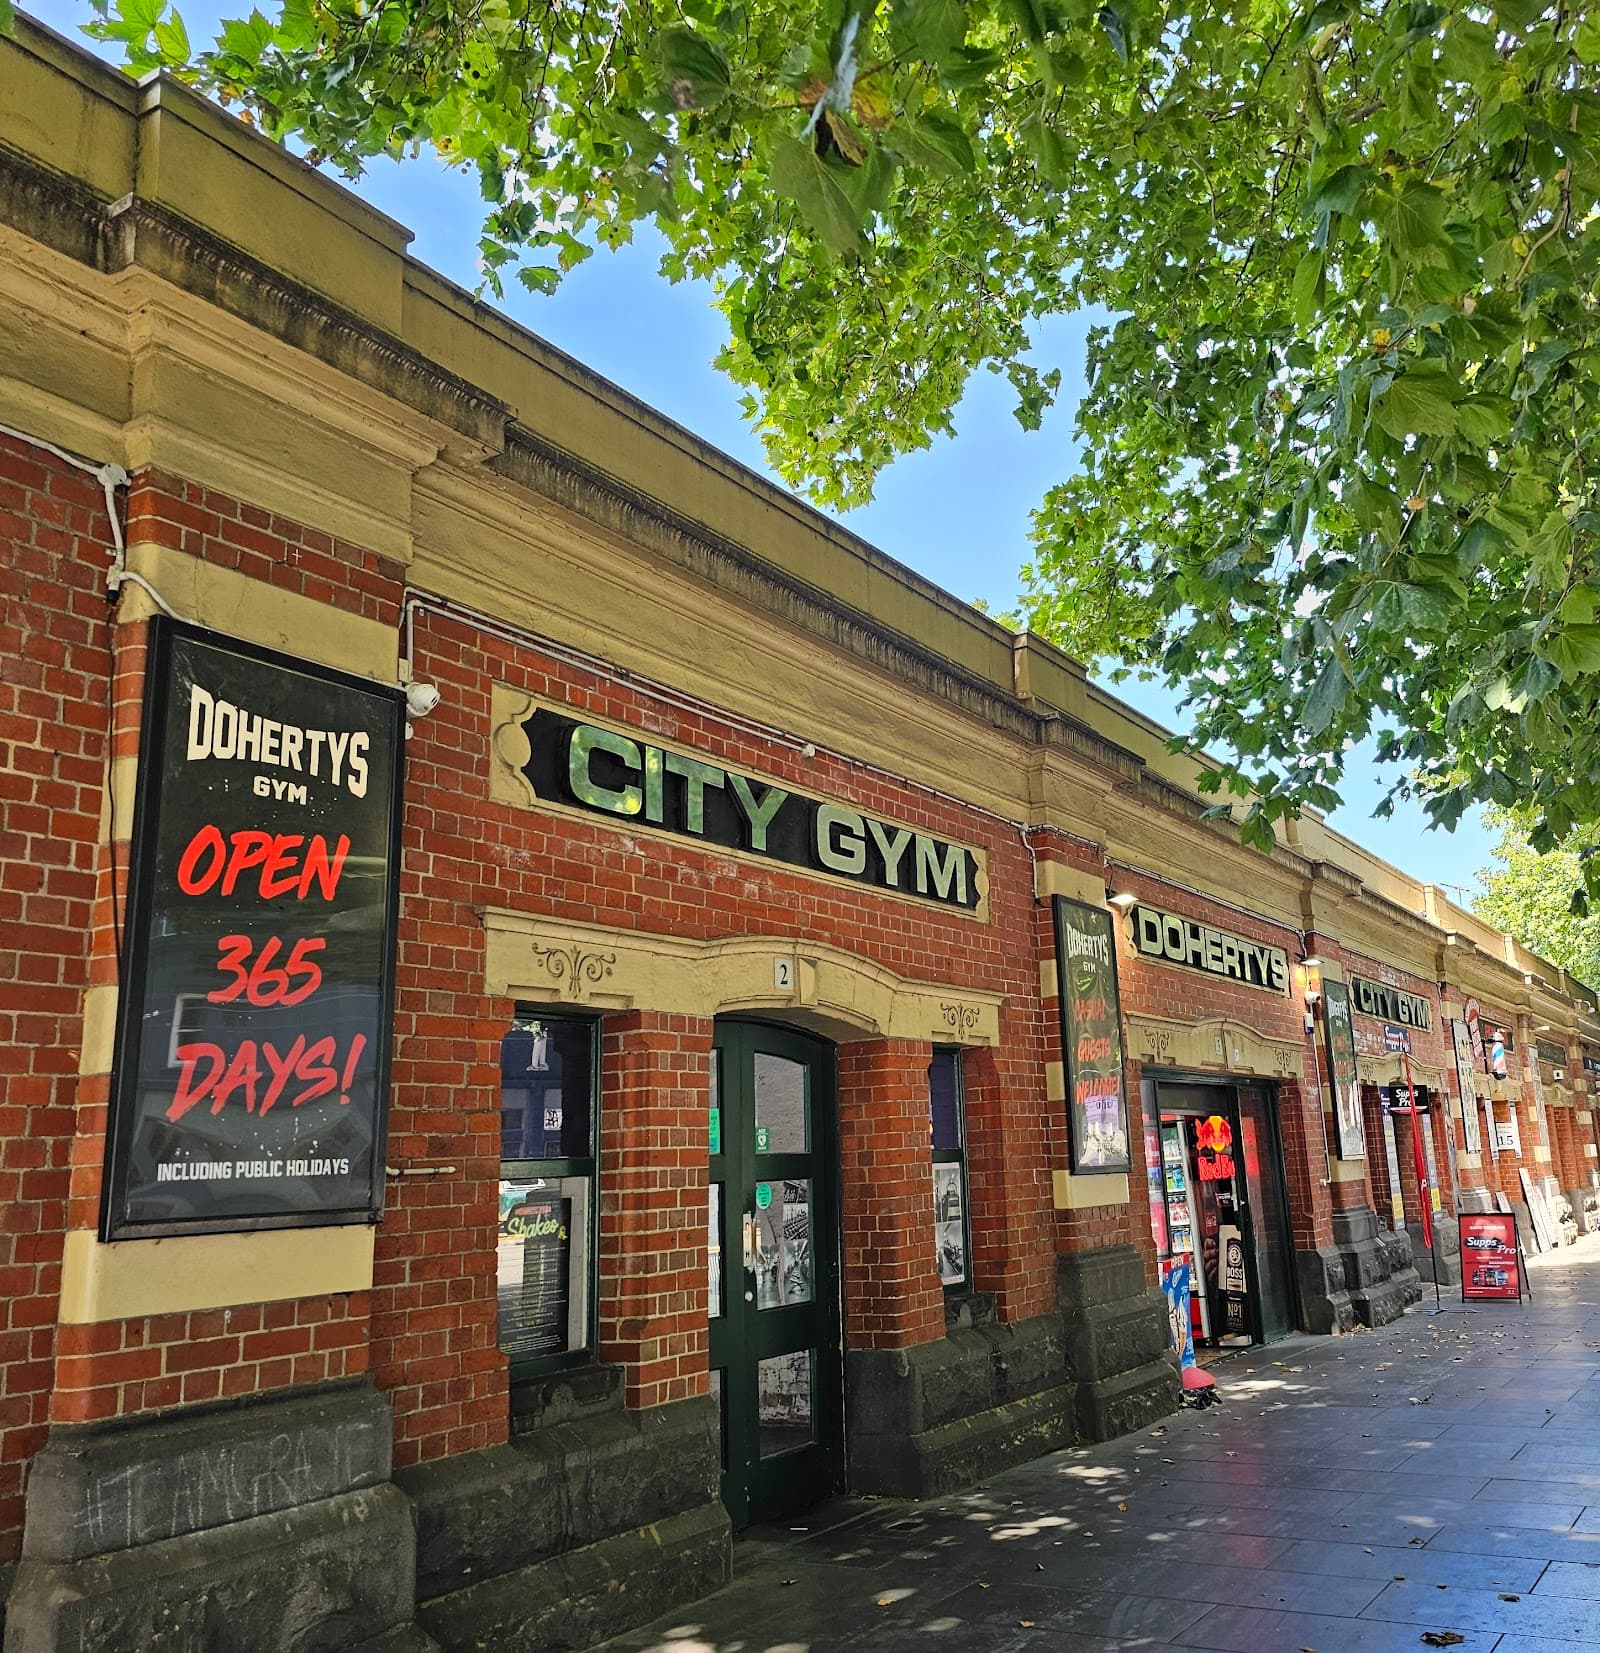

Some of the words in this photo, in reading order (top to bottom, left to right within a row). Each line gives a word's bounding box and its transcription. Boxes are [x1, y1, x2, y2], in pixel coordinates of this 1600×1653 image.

[187, 683, 370, 799] DOHERTYS
[253, 775, 308, 805] GYM
[569, 724, 788, 850] CITY
[816, 803, 967, 904] GYM
[177, 824, 351, 901] OPEN
[1066, 922, 1109, 967] DOHERTYS
[1137, 906, 1287, 990] DOHERTYS
[207, 934, 326, 1007] 365
[779, 963, 789, 985] 2
[1360, 980, 1394, 1018] CITY
[1398, 992, 1431, 1029] GYM
[165, 1033, 367, 1122] DAYS!
[1498, 1135, 1514, 1145] 15
[157, 1162, 232, 1181] INCLUDING
[235, 1160, 283, 1178] PUBLIC
[286, 1158, 349, 1176] HOLIDAYS
[508, 1214, 559, 1238] Shakes
[1467, 1236, 1498, 1248] Supps
[1496, 1244, 1517, 1255] Pro
